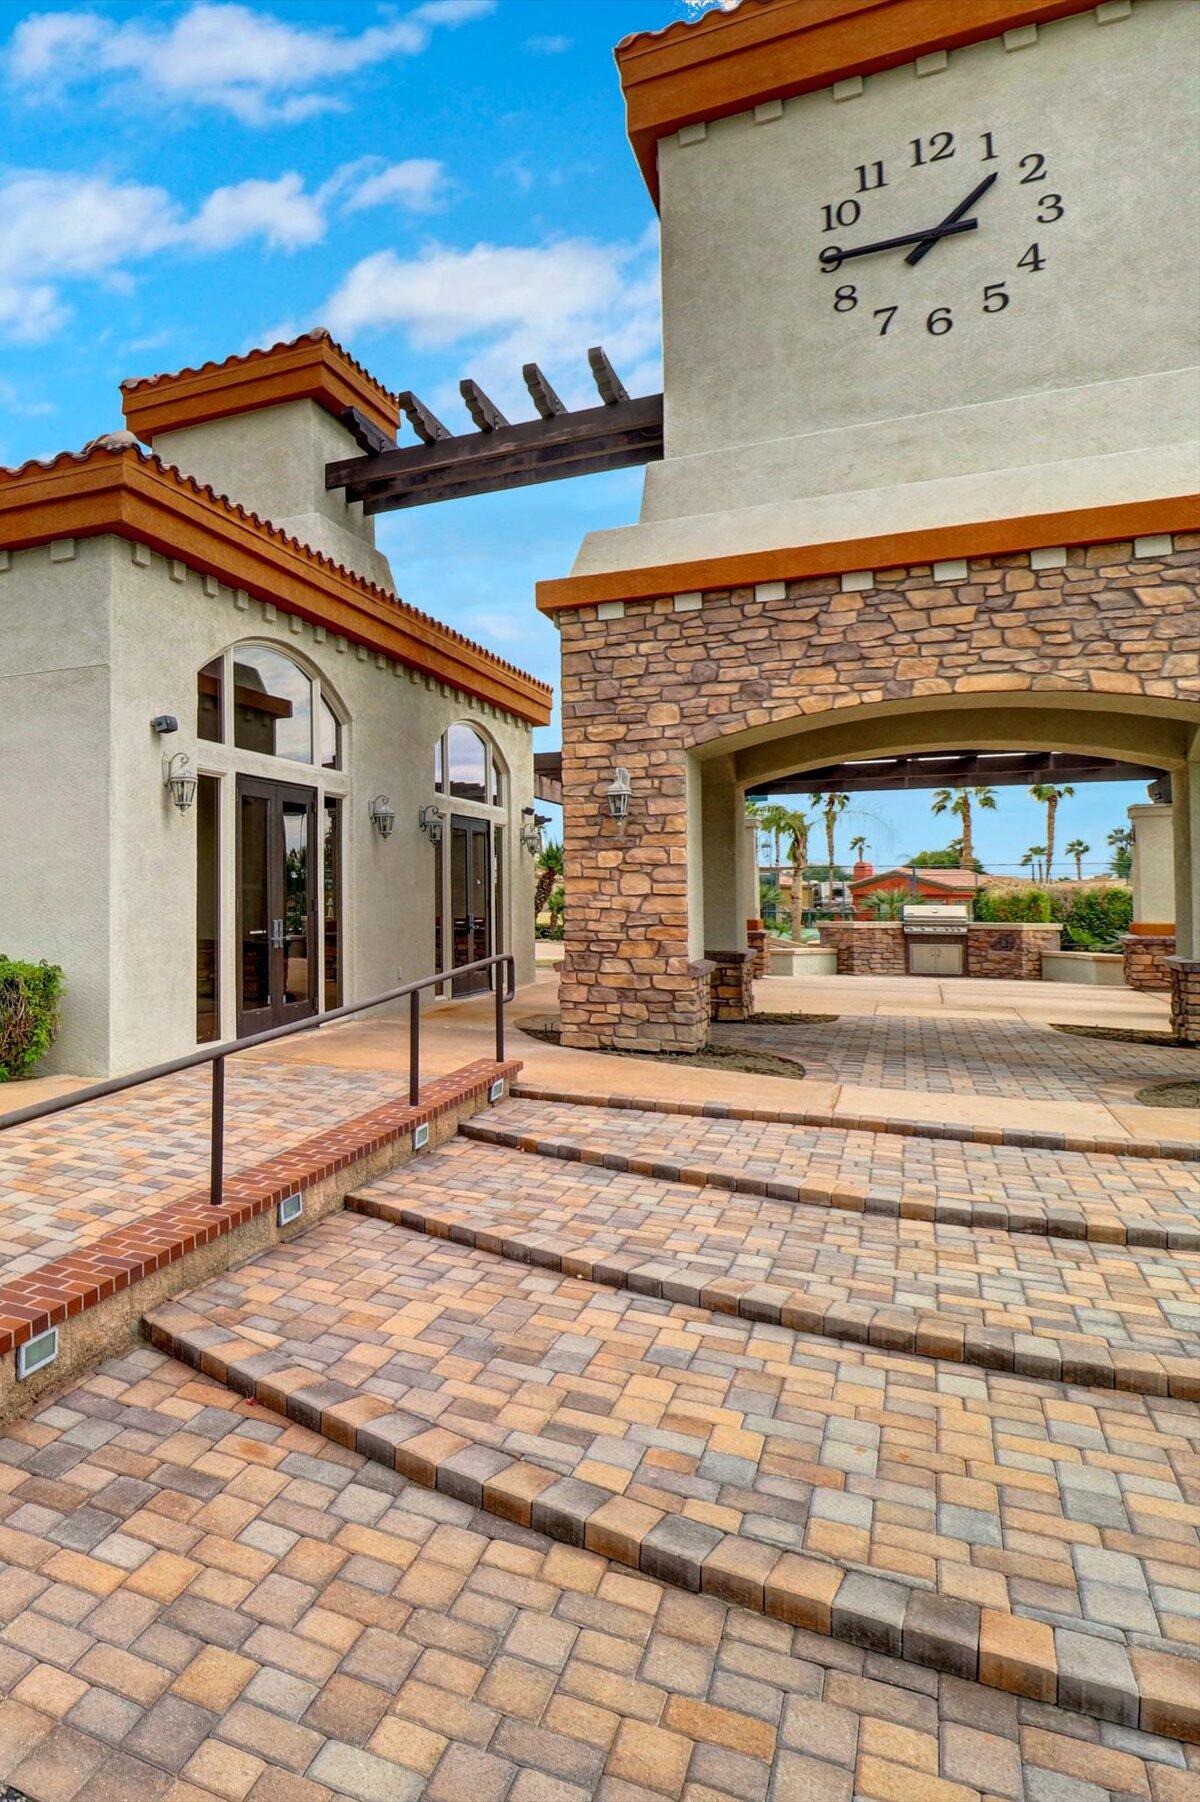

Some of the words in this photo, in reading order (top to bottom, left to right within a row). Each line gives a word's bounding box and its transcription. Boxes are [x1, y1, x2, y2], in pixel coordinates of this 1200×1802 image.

[909, 131, 956, 167] 12
[980, 131, 999, 161] 1
[854, 160, 889, 193] 11
[1019, 153, 1047, 184] 2
[820, 199, 861, 232] 10
[1036, 193, 1064, 223] 3
[818, 246, 844, 274] 9
[1016, 242, 1046, 272] 4
[833, 284, 859, 312] 8
[982, 281, 1010, 313] 5
[873, 305, 899, 336] 7
[926, 307, 953, 336] 6
